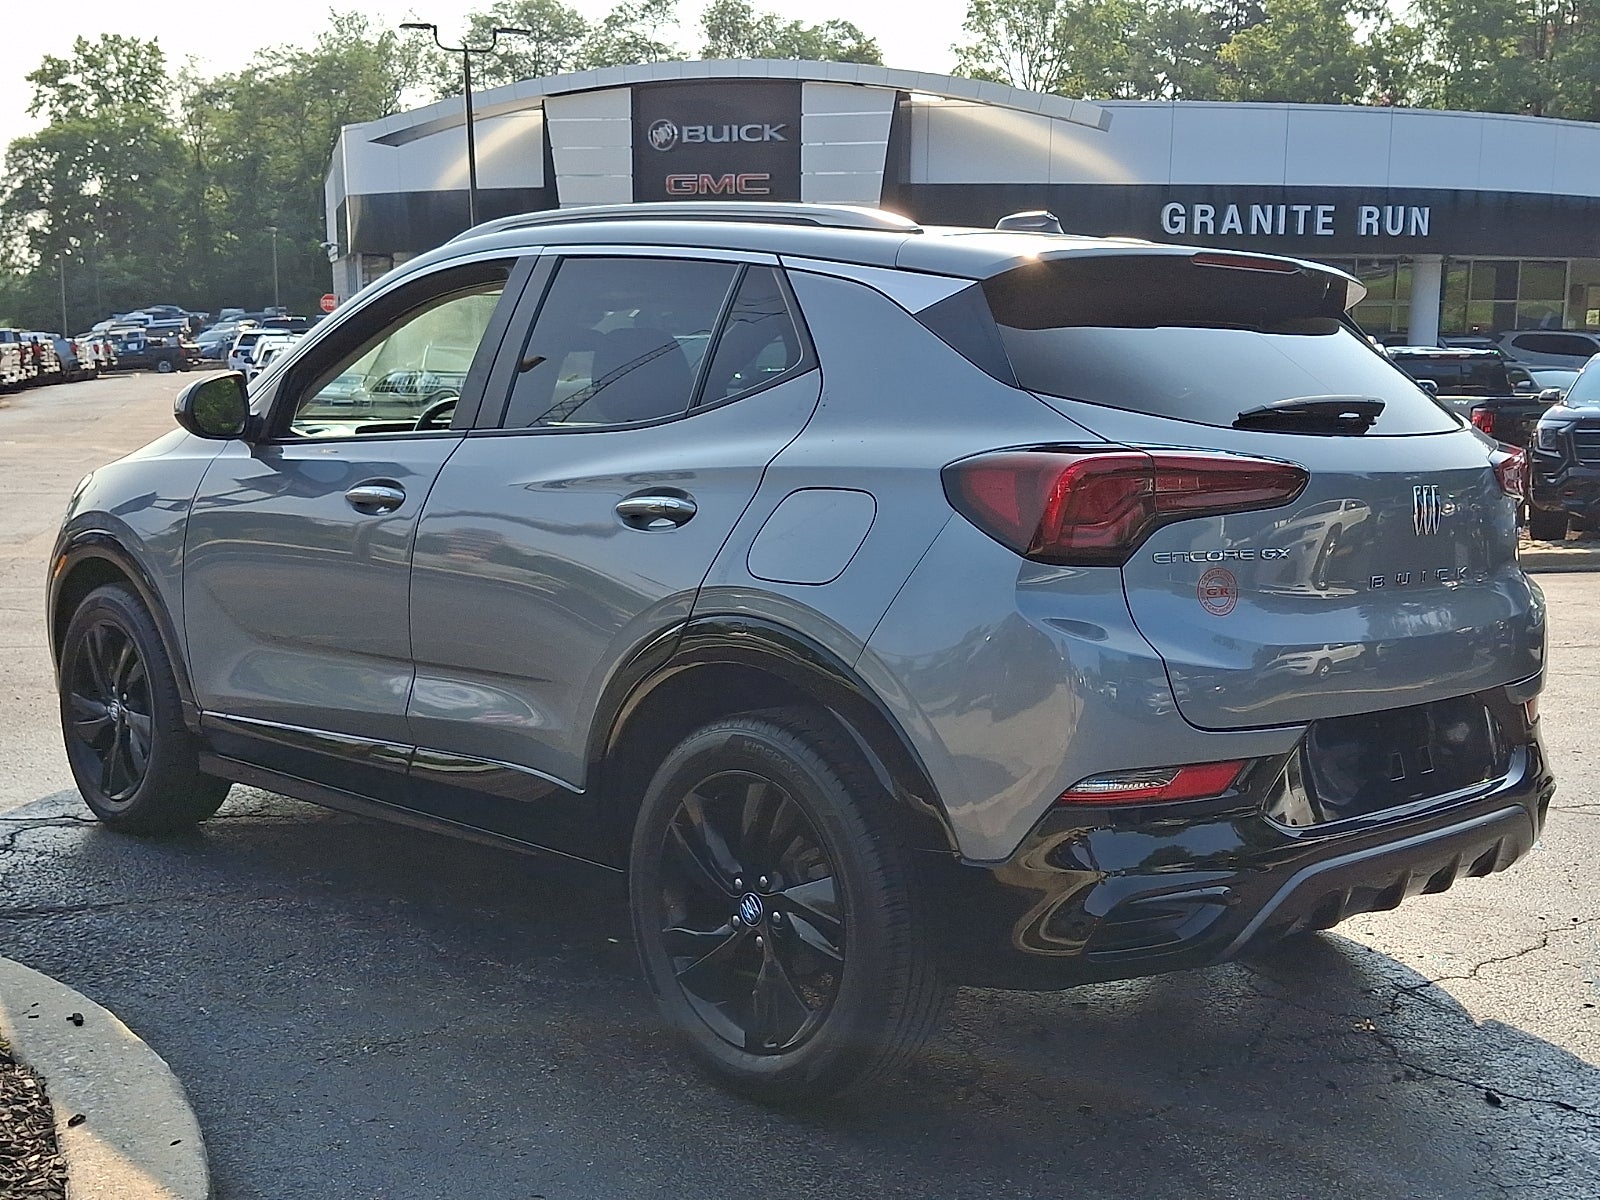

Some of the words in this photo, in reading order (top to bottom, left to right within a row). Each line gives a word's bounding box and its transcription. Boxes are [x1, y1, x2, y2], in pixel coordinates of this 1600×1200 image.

[682, 123, 788, 143] BUICK
[666, 173, 770, 195] GMC
[1161, 202, 1336, 235] GRANITE
[1358, 205, 1430, 236] RUN
[1152, 549, 1255, 564] ENCORE
[1260, 548, 1291, 560] GX
[1370, 566, 1468, 589] BUICK
[1206, 588, 1230, 596] GR
